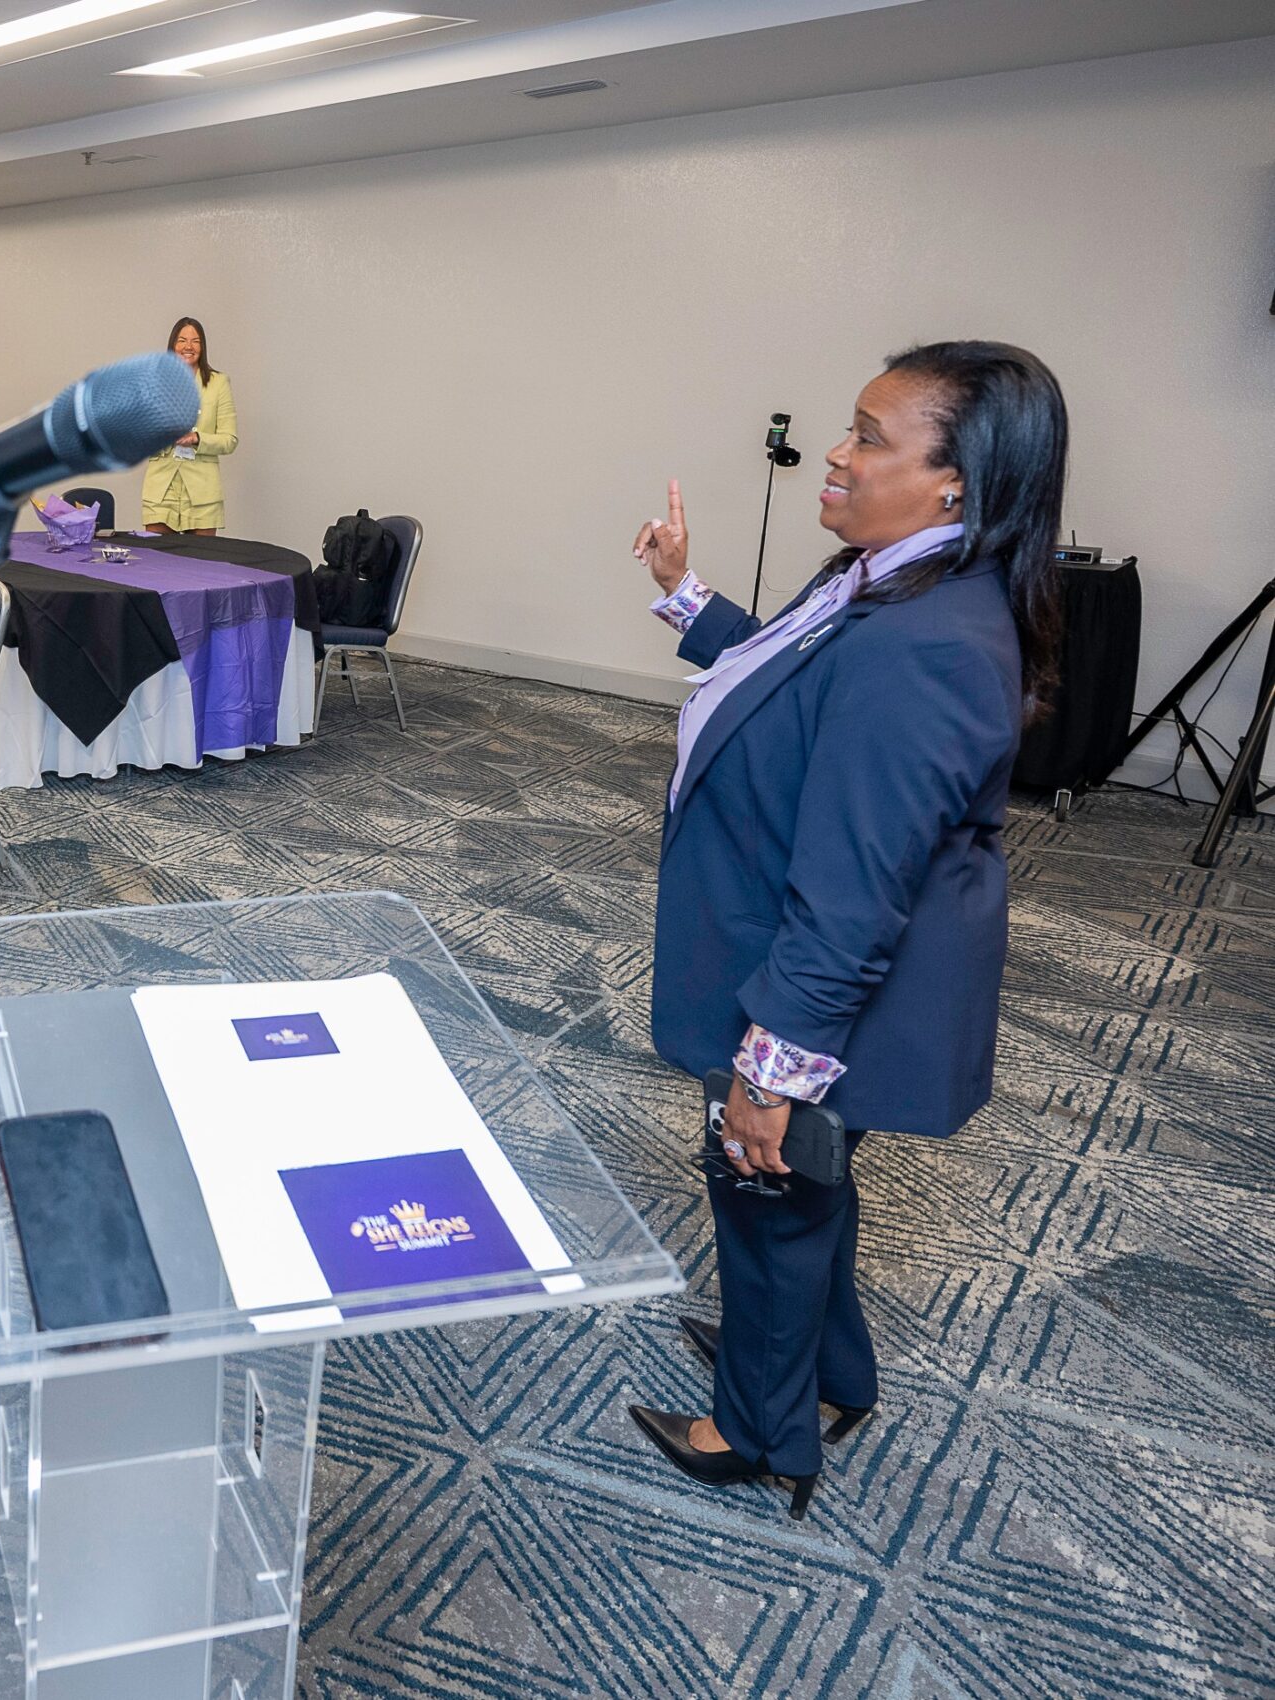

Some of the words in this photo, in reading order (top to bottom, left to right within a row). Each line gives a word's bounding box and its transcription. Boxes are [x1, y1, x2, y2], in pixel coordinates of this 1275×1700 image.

[363, 1215, 389, 1227] THE
[366, 1224, 404, 1244] SHE
[403, 1216, 470, 1239] REIGNS
